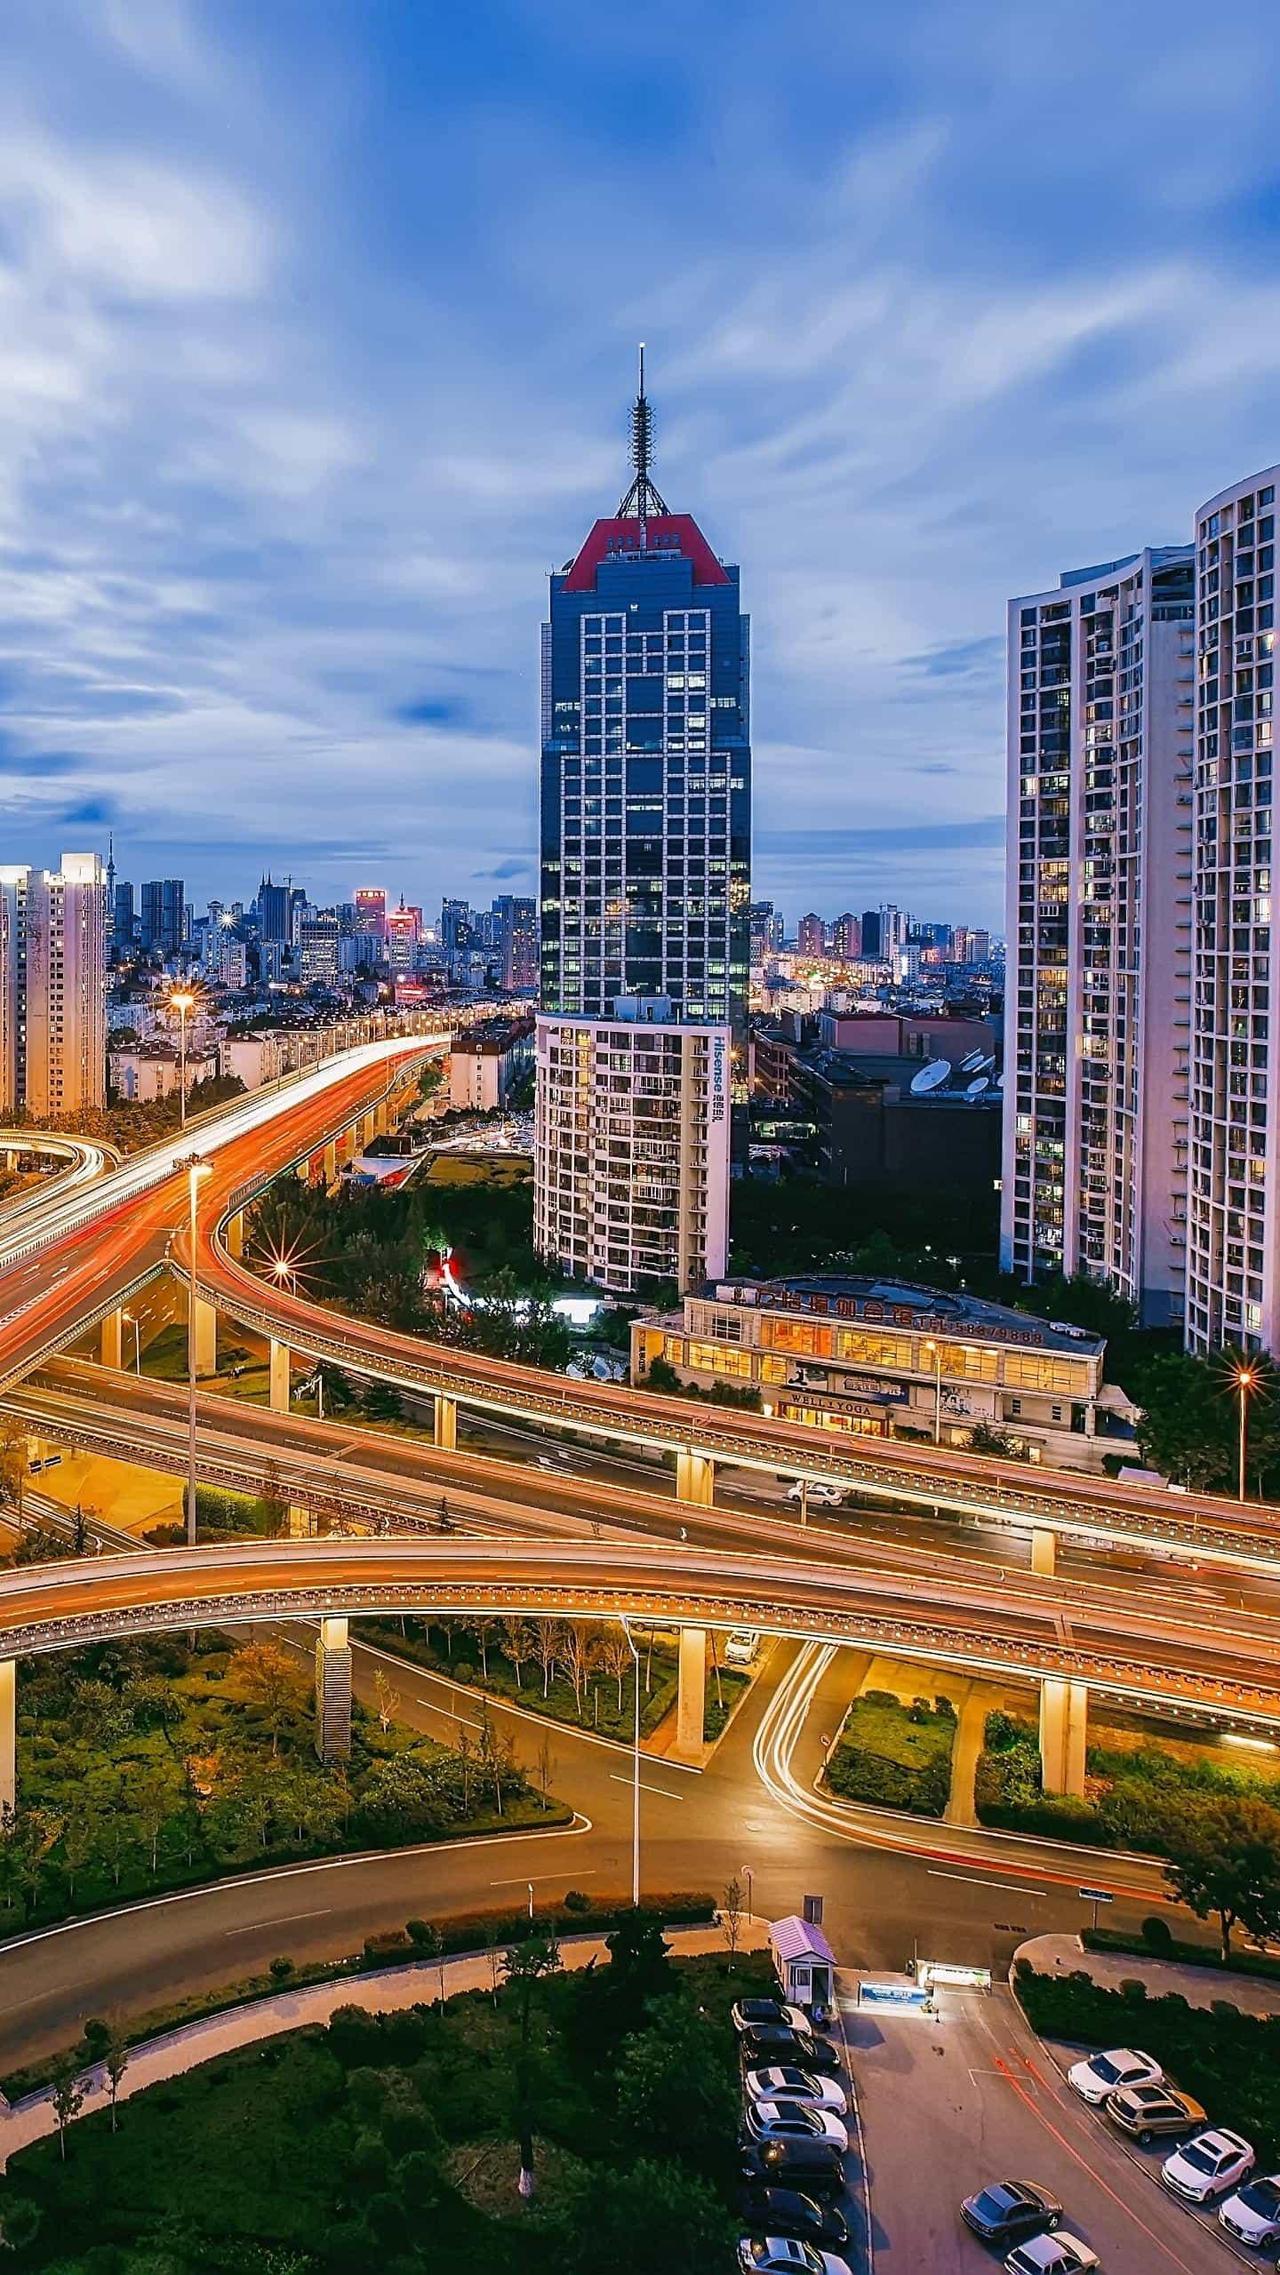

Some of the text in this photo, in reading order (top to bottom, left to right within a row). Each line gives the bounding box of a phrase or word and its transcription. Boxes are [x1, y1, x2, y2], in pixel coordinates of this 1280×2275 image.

[713, 1036, 725, 1093] Hisense
[790, 1393, 872, 1416] WELL YOGA
